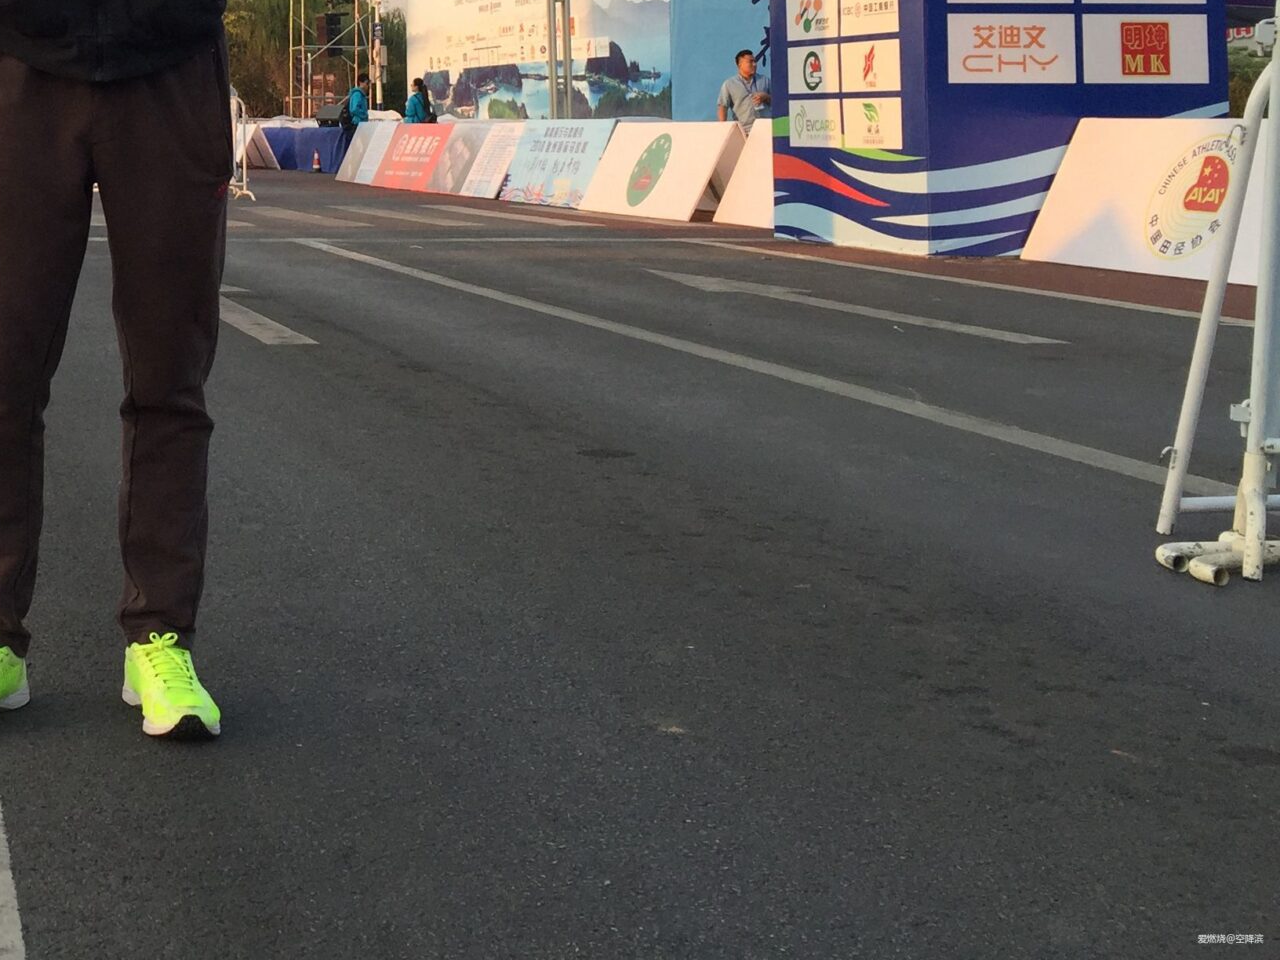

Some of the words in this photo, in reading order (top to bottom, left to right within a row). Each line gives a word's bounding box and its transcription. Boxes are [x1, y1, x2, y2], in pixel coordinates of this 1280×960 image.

[972, 25, 1046, 49] 艾迪文
[1123, 24, 1167, 50] 明坤
[1158, 157, 1189, 195] CHINESE
